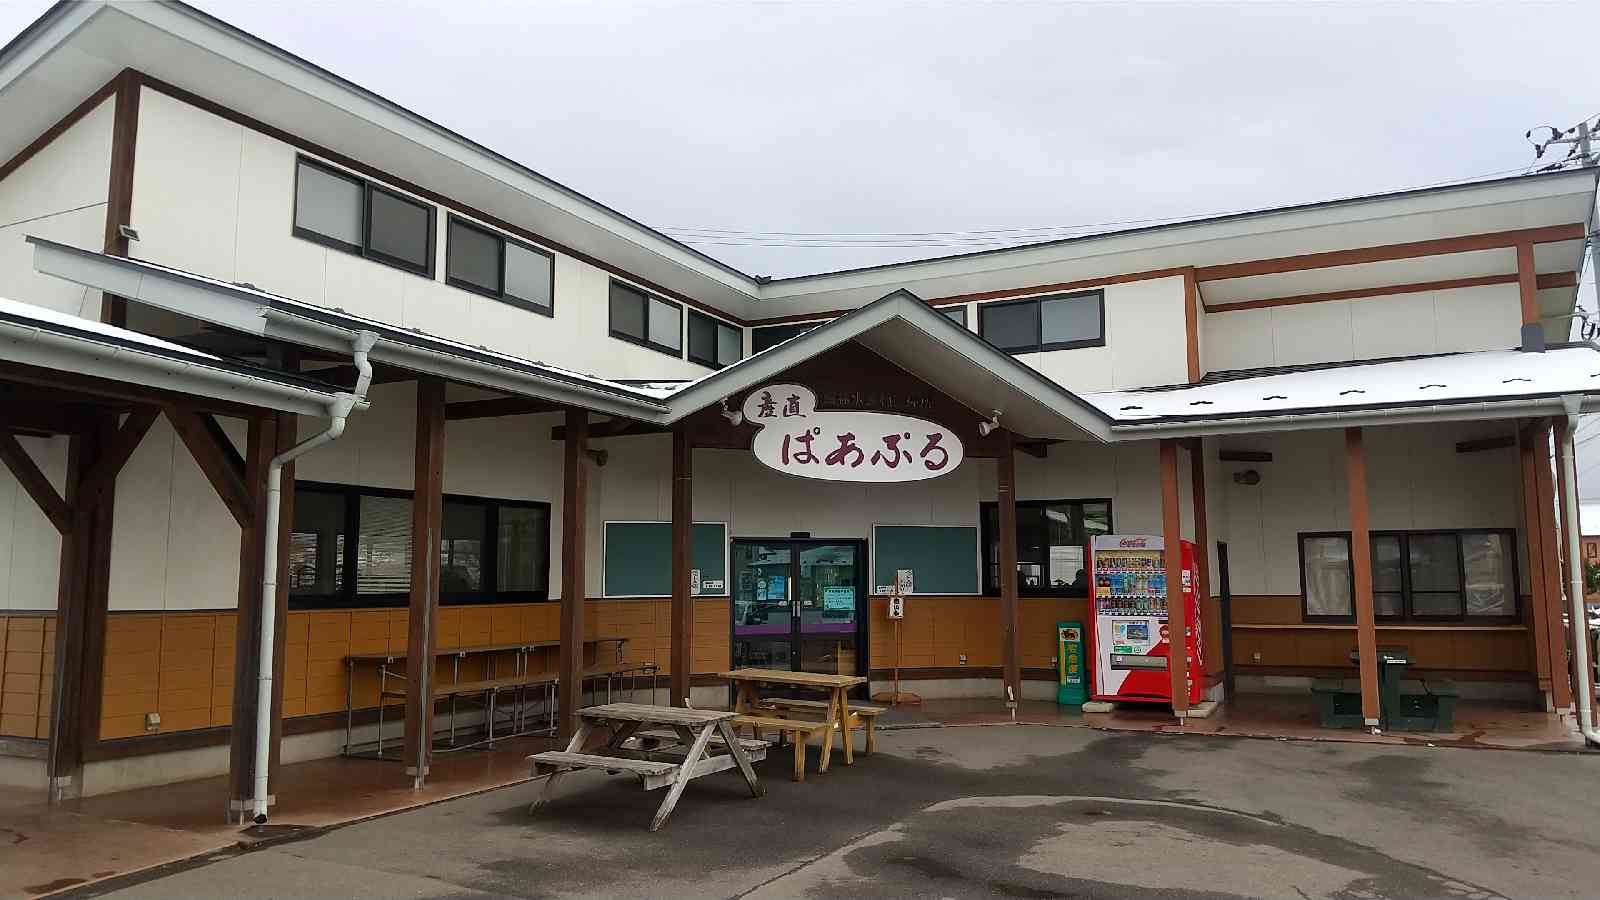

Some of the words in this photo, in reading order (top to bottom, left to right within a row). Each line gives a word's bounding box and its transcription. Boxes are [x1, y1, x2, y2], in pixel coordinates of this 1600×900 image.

[758, 392, 807, 418] 産直
[782, 427, 949, 470] ぱあぷる
